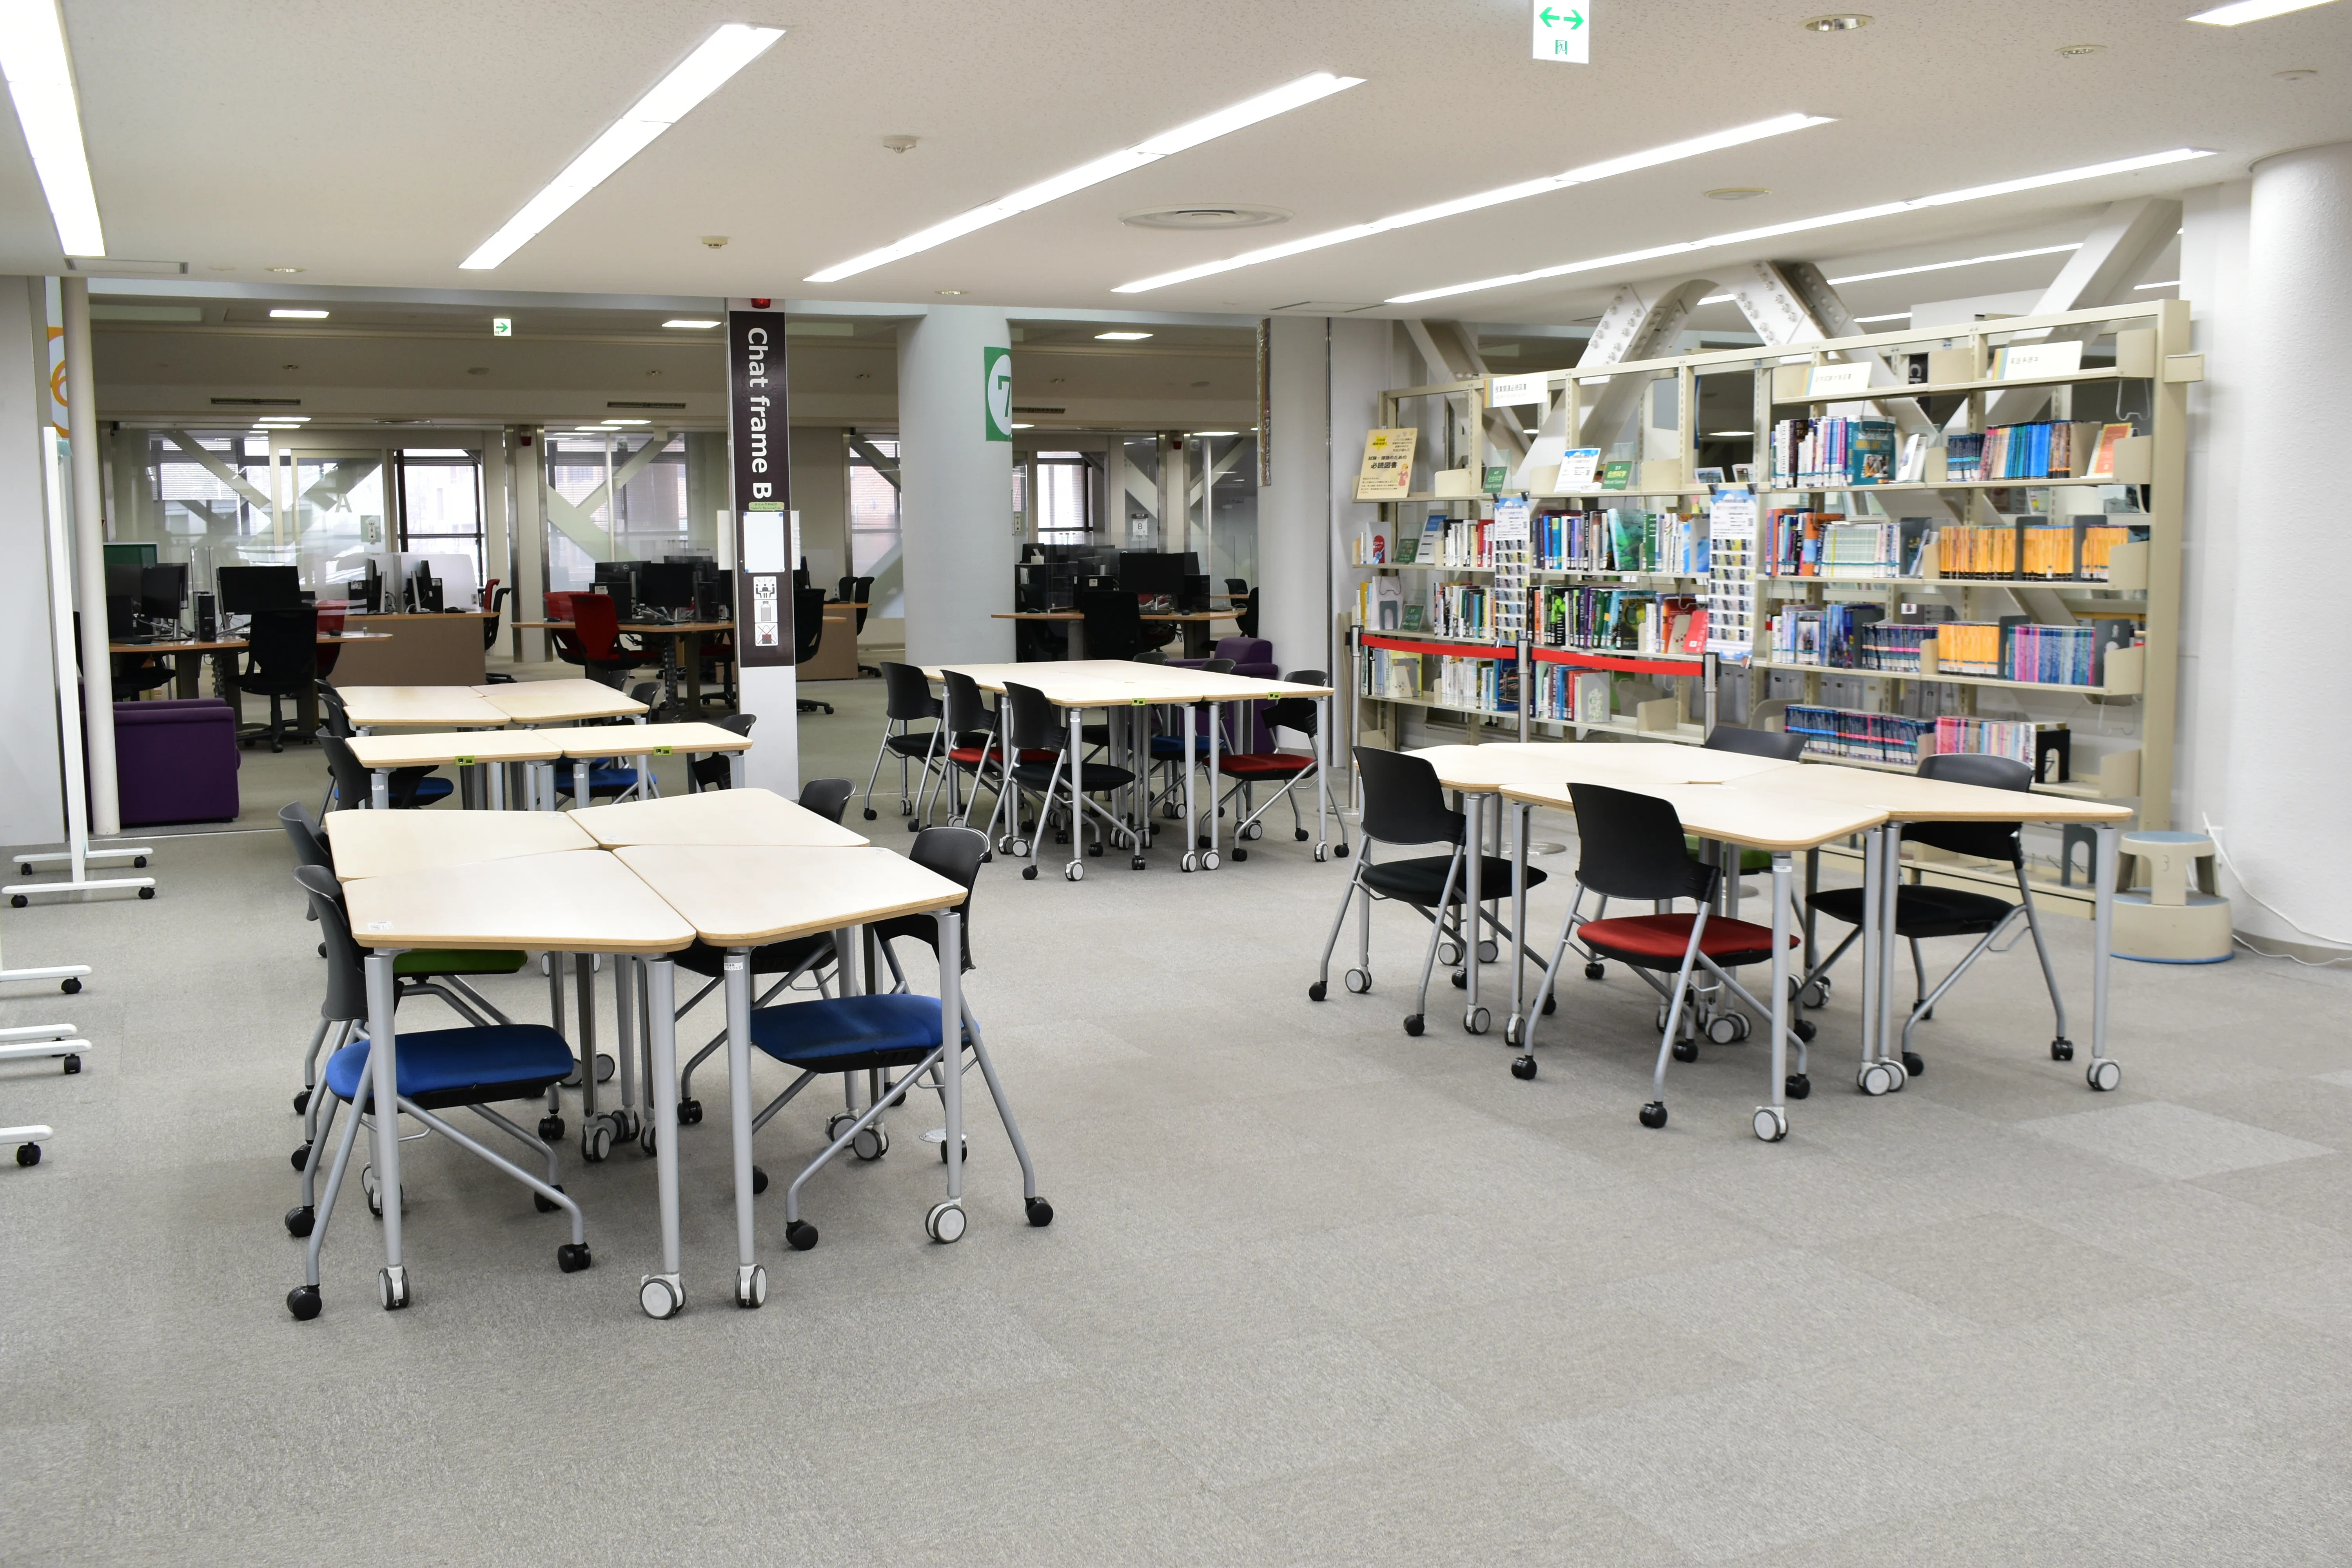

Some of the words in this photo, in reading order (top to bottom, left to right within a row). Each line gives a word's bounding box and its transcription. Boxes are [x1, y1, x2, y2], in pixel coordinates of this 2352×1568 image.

[748, 327, 768, 388] Chat
[998, 375, 1011, 417] 7
[750, 394, 770, 473] frame
[335, 494, 352, 513] A
[752, 482, 772, 499] B
